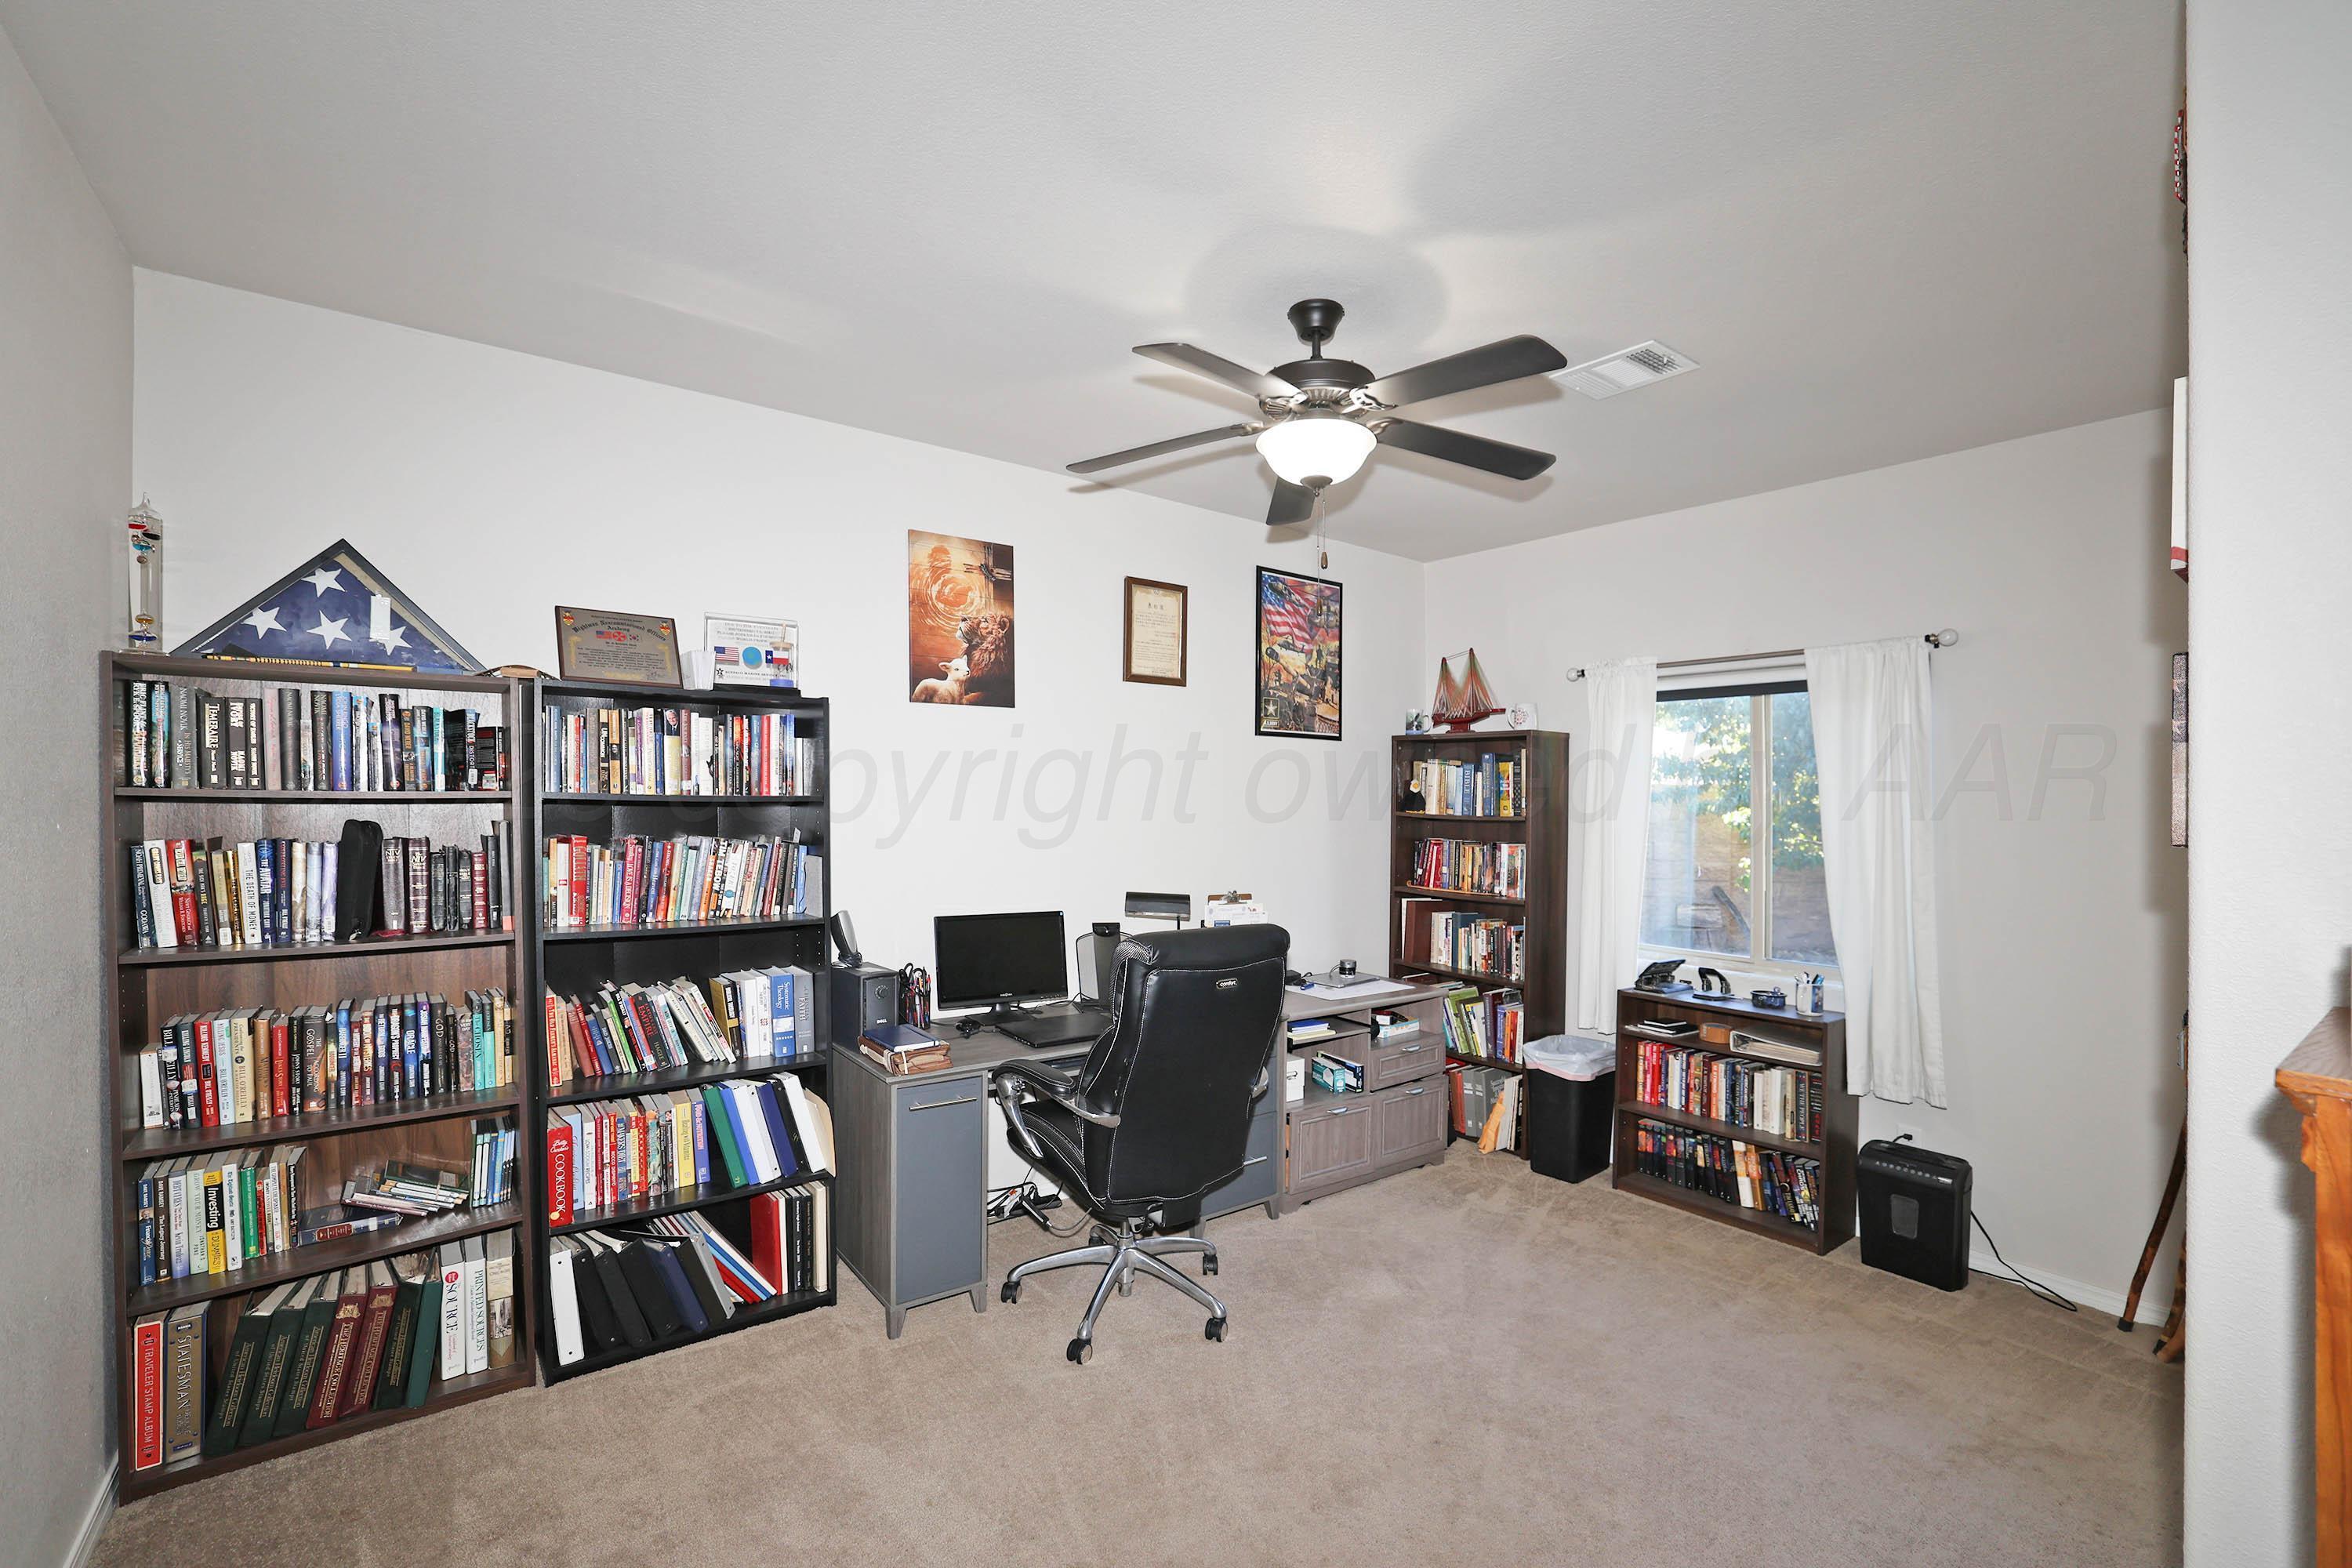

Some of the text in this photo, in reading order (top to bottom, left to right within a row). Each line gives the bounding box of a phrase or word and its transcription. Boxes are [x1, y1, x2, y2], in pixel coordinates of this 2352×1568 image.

[209, 704, 220, 748] TEMERAIRE
[230, 702, 238, 727] IVORY
[466, 713, 477, 742] BLACKSTOCK
[136, 864, 144, 887] PRIMEVAL
[245, 869, 253, 880] THE
[572, 847, 585, 880] GOLIATH
[713, 840, 728, 891] TIM TEBOW
[245, 882, 255, 900] DEATH
[260, 868, 271, 895] AVATAR
[623, 886, 633, 909] DECISION
[248, 911, 257, 931] MONEY
[419, 1010, 429, 1025] JOSIAH
[435, 1018, 444, 1037] GOD
[638, 1005, 653, 1036] EMPIRE
[653, 1041, 666, 1062] HAGEE
[163, 1029, 174, 1046] BILL
[201, 1043, 210, 1062] KENNEDY
[306, 1029, 315, 1056] GOSPEL
[362, 1024, 373, 1072] BOOK MYSTERIES
[390, 1015, 400, 1059] DRAGON'S PROPHECY
[406, 1030, 416, 1054] ORACLE
[474, 1026, 483, 1058] CHOSEN
[292, 1054, 301, 1069] JOHN'S
[275, 1073, 284, 1087] STORY
[1799, 1083, 1805, 1092] WE
[616, 1127, 626, 1163] MAKER'S DIET
[555, 1154, 566, 1214] COOKBOOK
[175, 1232, 185, 1243] Kevin
[207, 1187, 220, 1266] Investing DUMMIES
[176, 1244, 184, 1264] Trudeau
[375, 1311, 384, 1325] THE
[445, 1283, 459, 1334] SOURCE
[474, 1270, 485, 1352] PRINTED SOURCES
[342, 1323, 352, 1338] THE
[367, 1327, 383, 1360] HERITAGE
[289, 1342, 309, 1401] United States Stamps
[295, 1327, 321, 1408] American Heirloom Collection
[333, 1338, 350, 1373] HERITAGE
[176, 1336, 192, 1409] STATESMAN
[218, 1358, 239, 1419] United Stamps
[225, 1343, 252, 1427] American Heirloom Collection
[255, 1351, 275, 1410] United Stamps
[262, 1336, 287, 1418] American Heirloom Collection
[358, 1361, 374, 1405] COLLECTION
[143, 1348, 155, 1443] TRAVELER STAMP ALBUM
[324, 1374, 341, 1417] COLLECTION
